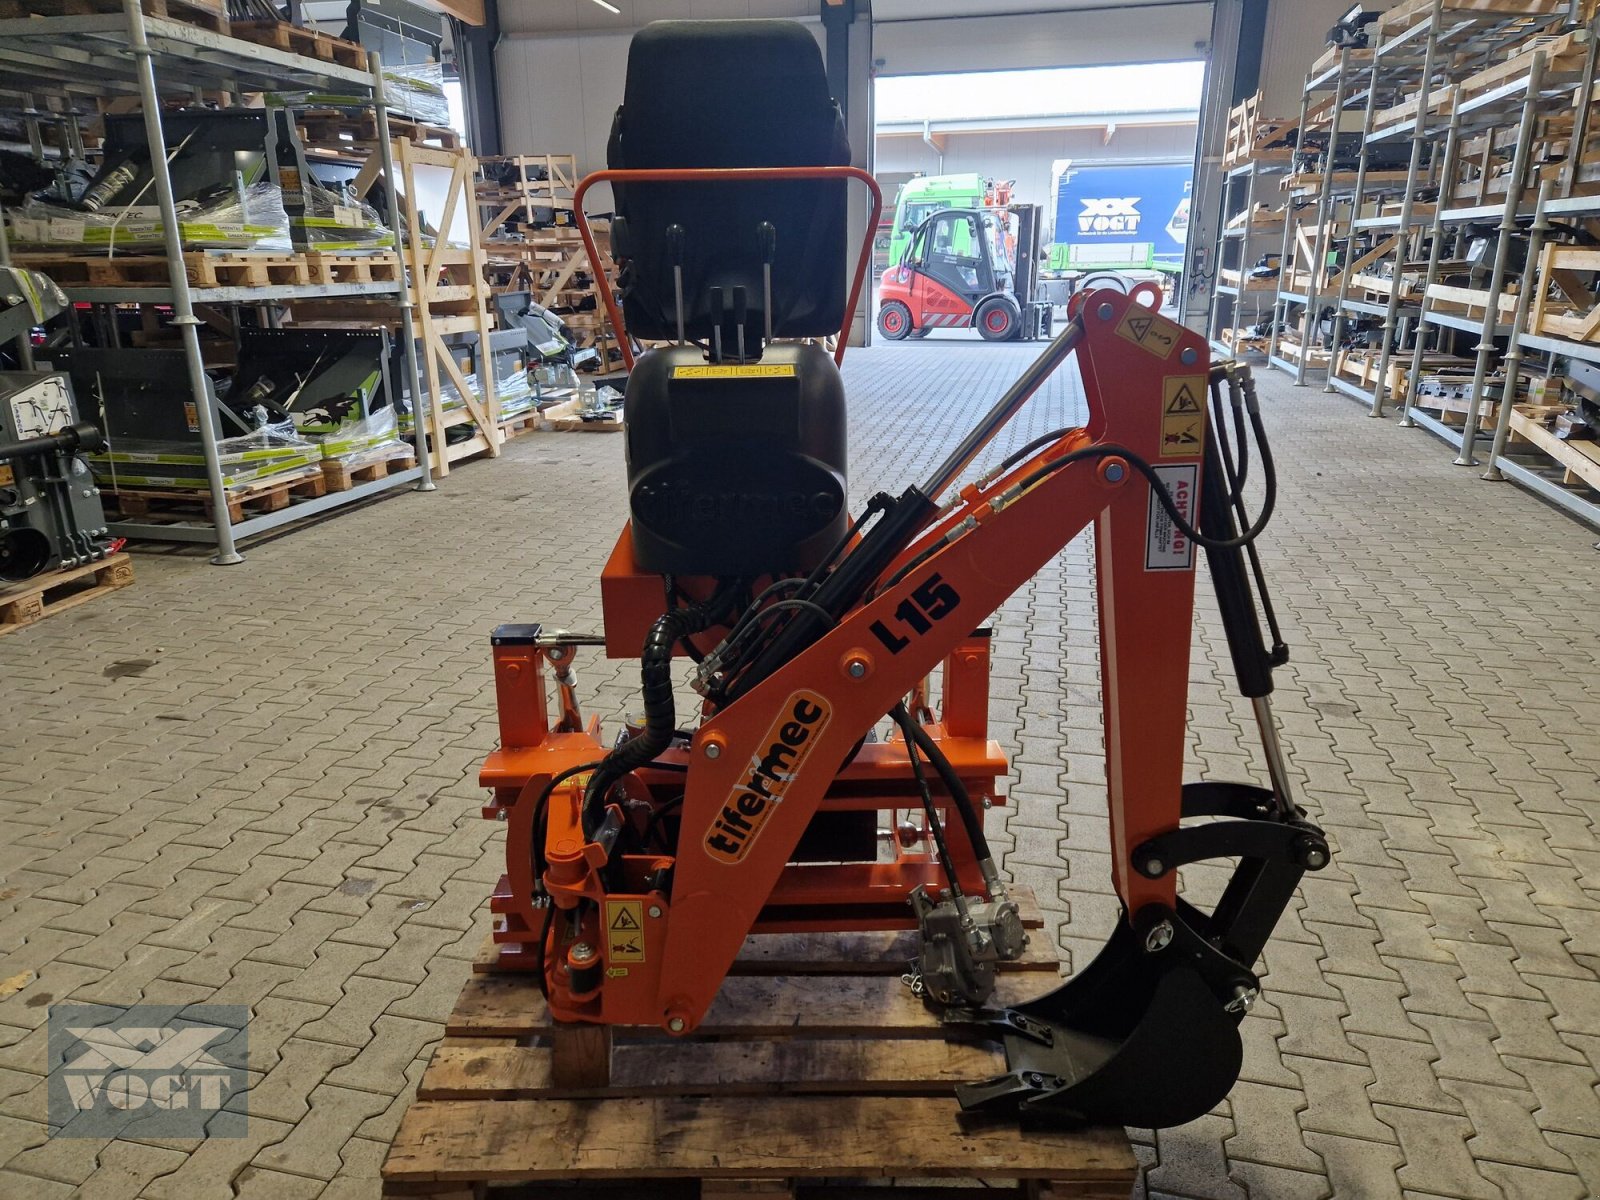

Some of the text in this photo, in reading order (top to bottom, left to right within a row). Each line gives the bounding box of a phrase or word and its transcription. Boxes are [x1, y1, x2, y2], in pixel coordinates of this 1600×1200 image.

[1078, 216, 1141, 231] VOGT
[1173, 480, 1189, 555] ACHTNG!
[707, 698, 822, 854] tifermec
